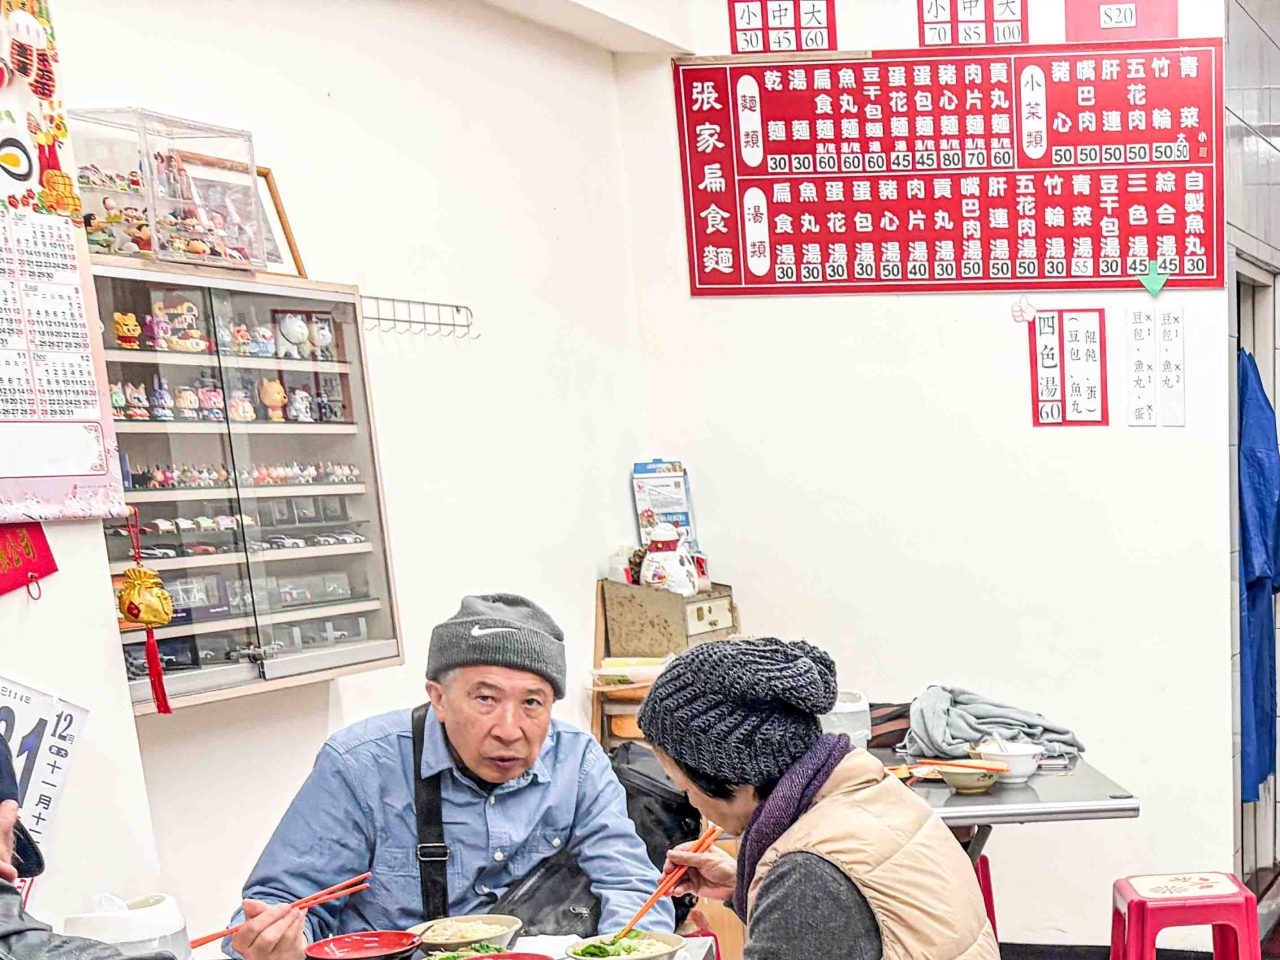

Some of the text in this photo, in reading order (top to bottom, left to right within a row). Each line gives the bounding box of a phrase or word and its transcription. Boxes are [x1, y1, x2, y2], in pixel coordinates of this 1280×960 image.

[740, 4, 822, 26] 小 中 大
[741, 30, 824, 50] 30 45 60
[927, 0, 946, 19] 小
[929, 25, 1020, 42] 70 85 100
[740, 94, 760, 149] 麵類
[764, 70, 787, 171] 乾麵 30
[788, 69, 811, 170] 湯麵 30
[813, 68, 834, 140] 扁食麵
[838, 68, 860, 139] 魚丸麵
[862, 66, 884, 137] 豆干包麵
[887, 66, 909, 137] 蛋花麵
[912, 65, 935, 136] 蛋包麵
[937, 64, 959, 135] 豬心麵
[964, 63, 985, 135] 肉片麵
[989, 62, 1010, 134] 貢丸麵
[1024, 74, 1043, 149] 小菜類
[1051, 61, 1072, 162] 豬心 50
[1076, 59, 1098, 162] 嘴巴肉 50
[1101, 59, 1122, 161] 肝連 50
[1126, 58, 1147, 160] 五花肉 50
[1151, 57, 1173, 159] 竹輪 50
[1179, 55, 1199, 128] 青菜
[691, 81, 735, 274] 張家扁食麵
[818, 156, 835, 169] 60
[843, 155, 861, 169] 60
[867, 155, 884, 169] 60
[892, 152, 911, 167] 45
[916, 152, 935, 167] 45
[942, 152, 960, 166] 80
[967, 151, 985, 165] 70
[993, 151, 1011, 165] 60
[1176, 144, 1188, 158] 50
[747, 205, 767, 258] 湯類
[772, 182, 796, 279] 扁食湯 30
[798, 182, 822, 279] 魚丸湯 30
[824, 181, 847, 278] 蛋花湯 30
[852, 180, 875, 276] 蛋包湯 30
[878, 179, 901, 277] 豬心湯 50
[907, 179, 928, 276] 肉片湯 40
[932, 178, 955, 276] 貢丸湯 30
[959, 175, 982, 275] 嘴巴肉湯 50
[988, 176, 1010, 275] 肝連湯 50
[1015, 174, 1037, 275] 五花肉湯 50
[1044, 174, 1065, 274] 竹輪湯 30
[1071, 174, 1093, 273] 青菜湯 55
[1099, 174, 1121, 273] 豆干包湯 30
[1127, 173, 1149, 273] 三色湯 45
[1155, 171, 1178, 272] 綜合湯 45
[1184, 170, 1205, 272] 自製魚丸 30
[1038, 315, 1061, 421] 四色湯 60
